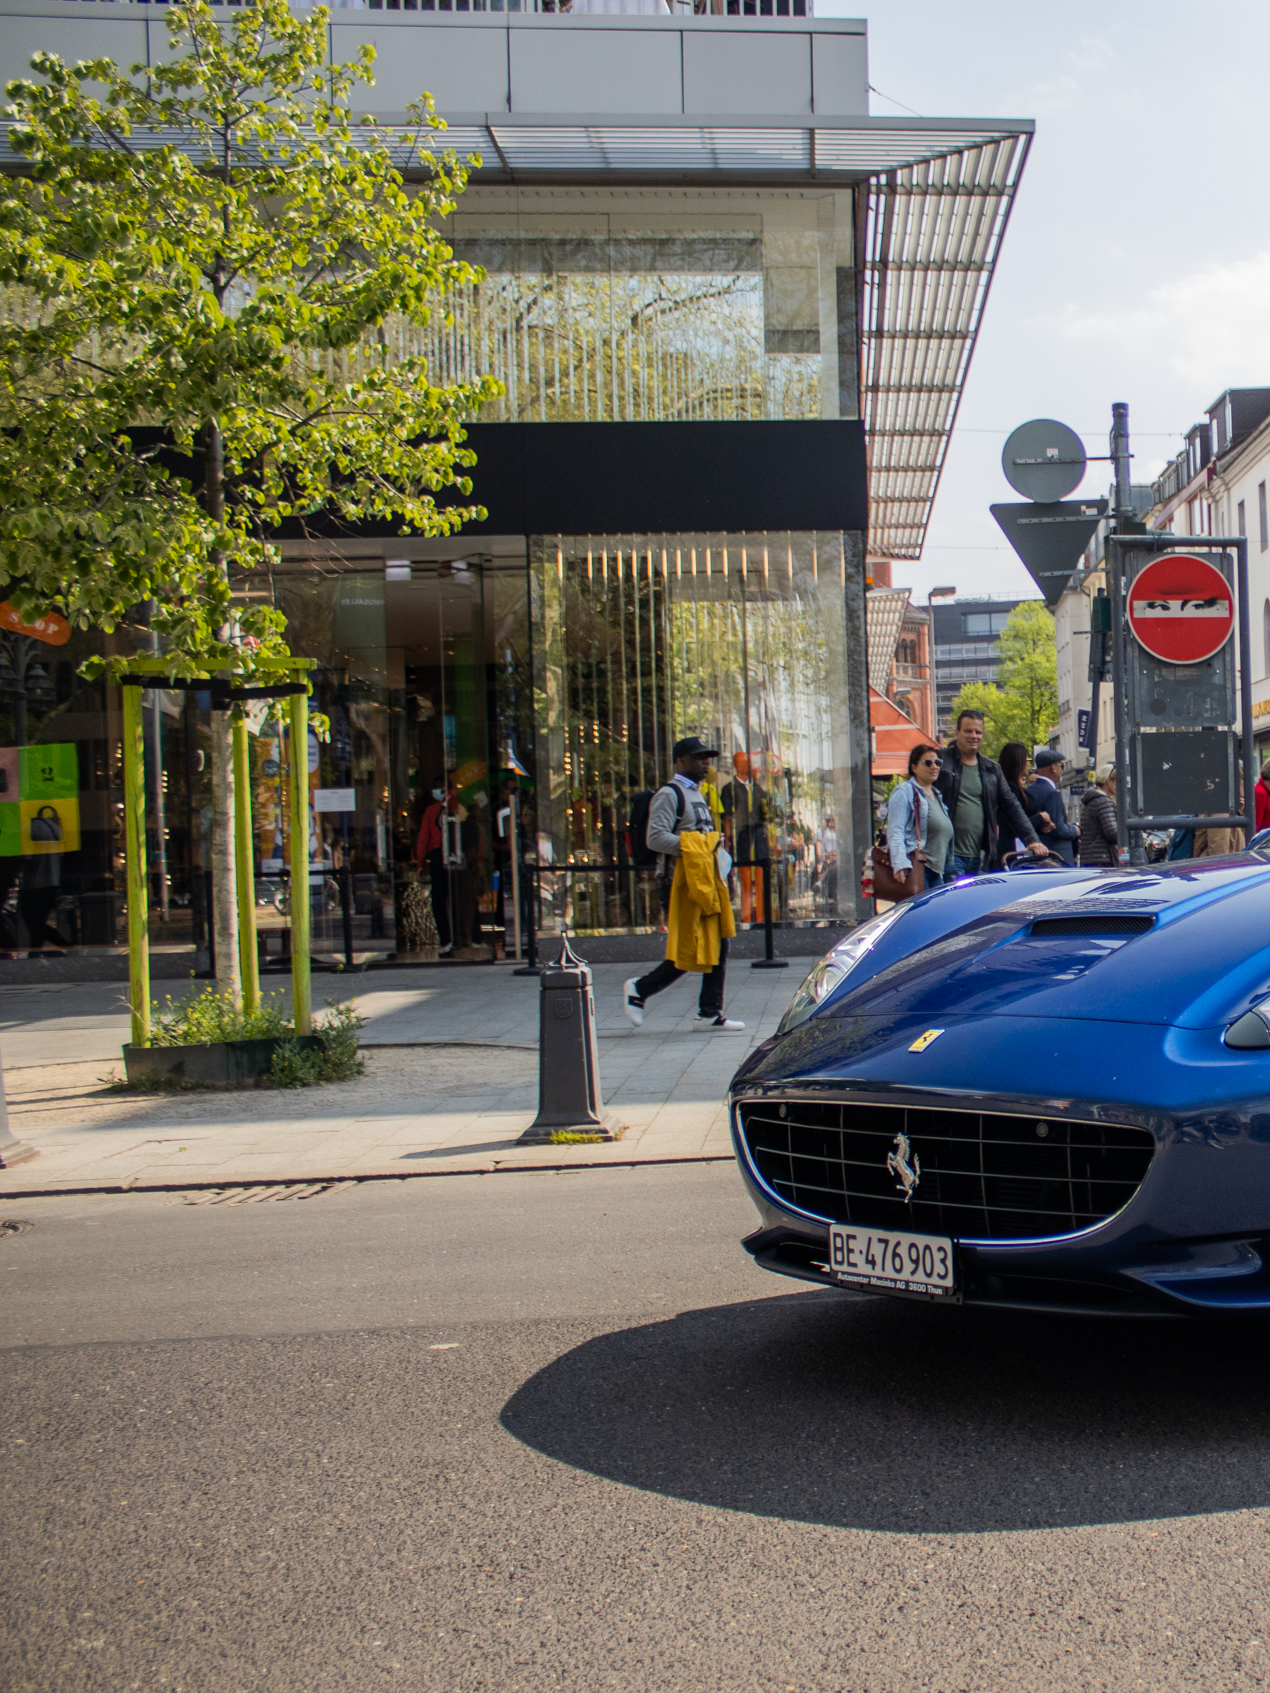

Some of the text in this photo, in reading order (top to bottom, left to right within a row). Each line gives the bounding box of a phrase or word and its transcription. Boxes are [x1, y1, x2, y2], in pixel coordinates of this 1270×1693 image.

[8, 610, 60, 635] SOP
[1079, 714, 1088, 743] KUHN
[837, 1272, 870, 1285] Autocenter
[896, 1280, 906, 1290] AG
[908, 1282, 926, 1293] 3600
[927, 1285, 943, 1295] Thun
